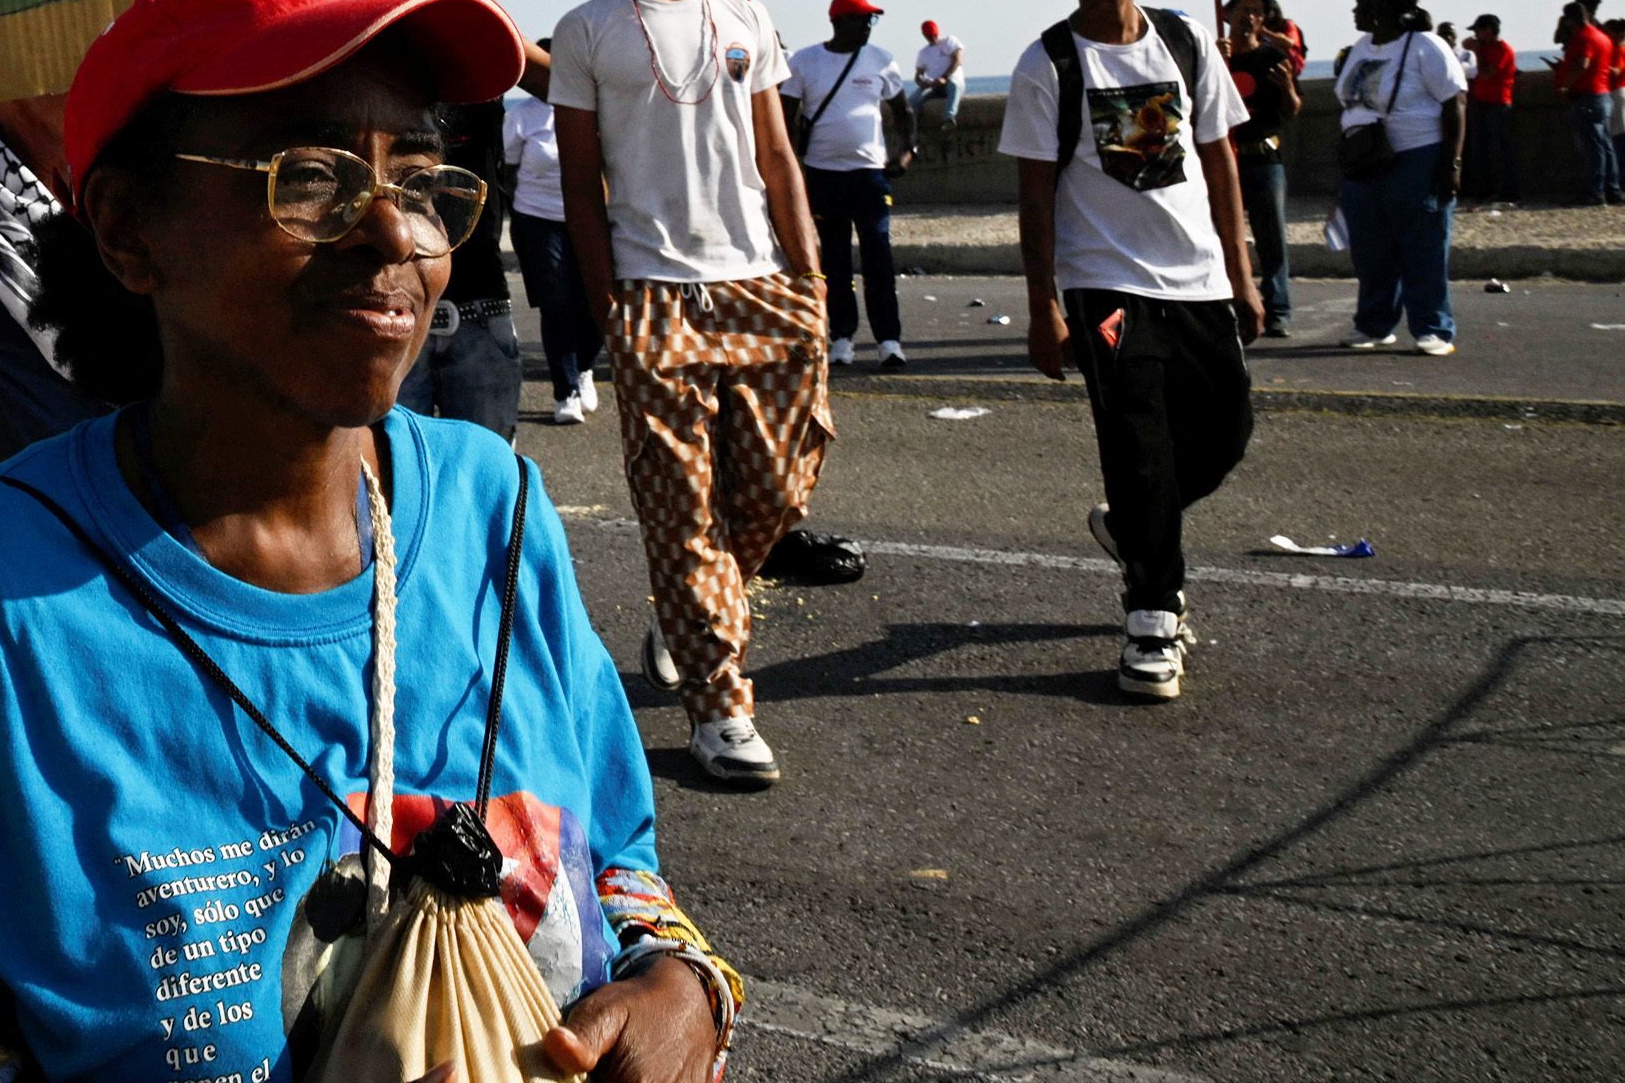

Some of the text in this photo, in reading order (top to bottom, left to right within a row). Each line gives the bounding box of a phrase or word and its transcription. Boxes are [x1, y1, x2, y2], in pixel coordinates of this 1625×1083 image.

[219, 840, 254, 861] me
[258, 819, 316, 851] dirán
[136, 847, 306, 909] aventurero, y lo
[144, 887, 286, 939] soy, sólo que
[150, 927, 268, 970] de un tipo
[155, 962, 263, 1002] diferente
[159, 1000, 254, 1041] y de los
[165, 1044, 217, 1071] que
[250, 1058, 273, 1083] el
